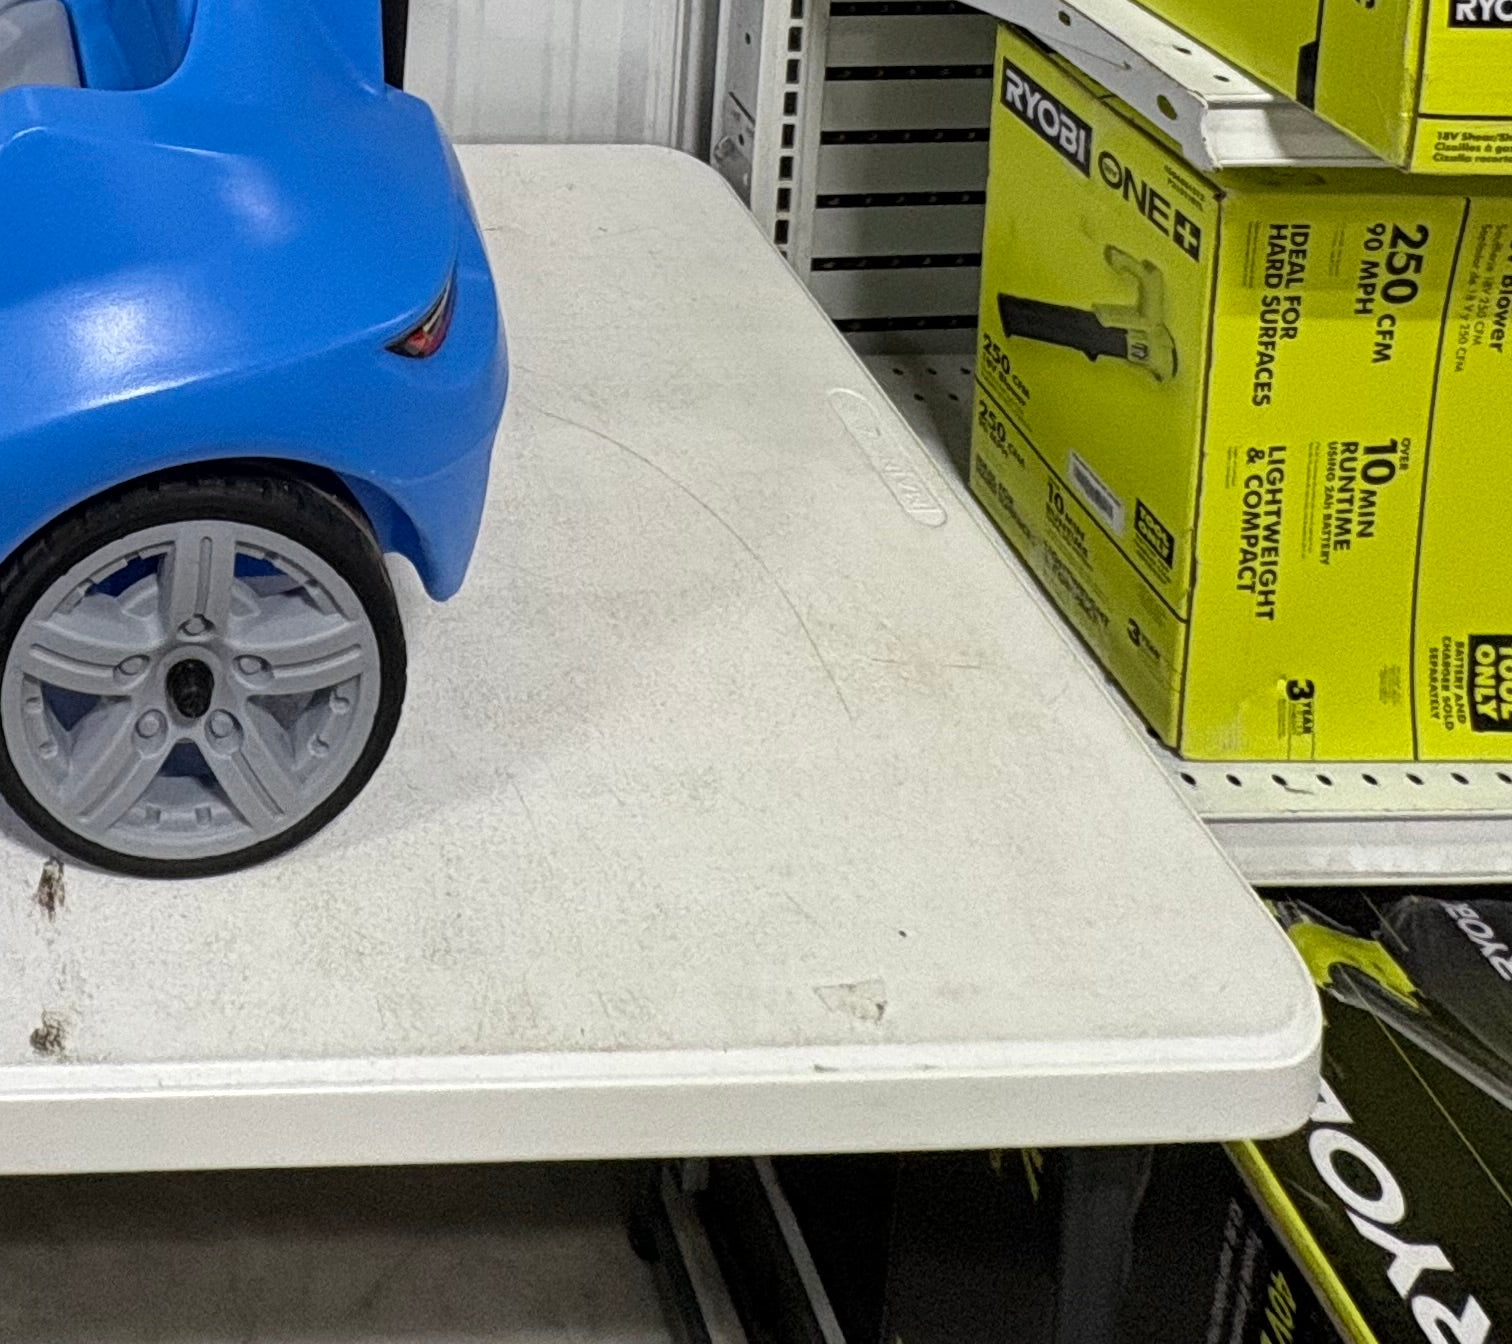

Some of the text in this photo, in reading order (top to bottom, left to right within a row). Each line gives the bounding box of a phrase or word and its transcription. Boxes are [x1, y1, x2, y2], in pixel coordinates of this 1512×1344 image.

[1005, 68, 1086, 162] RYOBI
[1264, 224, 1289, 289] HARD
[1279, 224, 1311, 340] IDEAL FOR
[1354, 223, 1386, 315] 90 MPH
[1371, 223, 1429, 364] 250 CFM
[1252, 295, 1281, 407] SURFACES
[1454, 323, 1470, 373] 250 CFM
[1489, 275, 1512, 353] Blower
[983, 333, 1011, 375] 250
[978, 400, 1007, 442] 250
[1399, 437, 1411, 470] OVER
[1048, 481, 1064, 513] 10
[1326, 441, 1339, 481] USING
[1333, 441, 1359, 551] RUNTIME
[1356, 438, 1398, 538] 10 MIN
[1236, 447, 1265, 594] & COMPACT
[1255, 446, 1287, 621] LIGHTWEIGHT
[1320, 513, 1333, 565] BATTERY
[1127, 617, 1141, 648] 3
[1286, 679, 1315, 700] 3
[1429, 647, 1440, 720] SEPARATELY
[1441, 636, 1454, 731] CHARGER SOLD
[1454, 641, 1466, 724] BATTERY AND
[1474, 644, 1499, 721] ONLY
[1309, 1076, 1491, 1344] RYO
